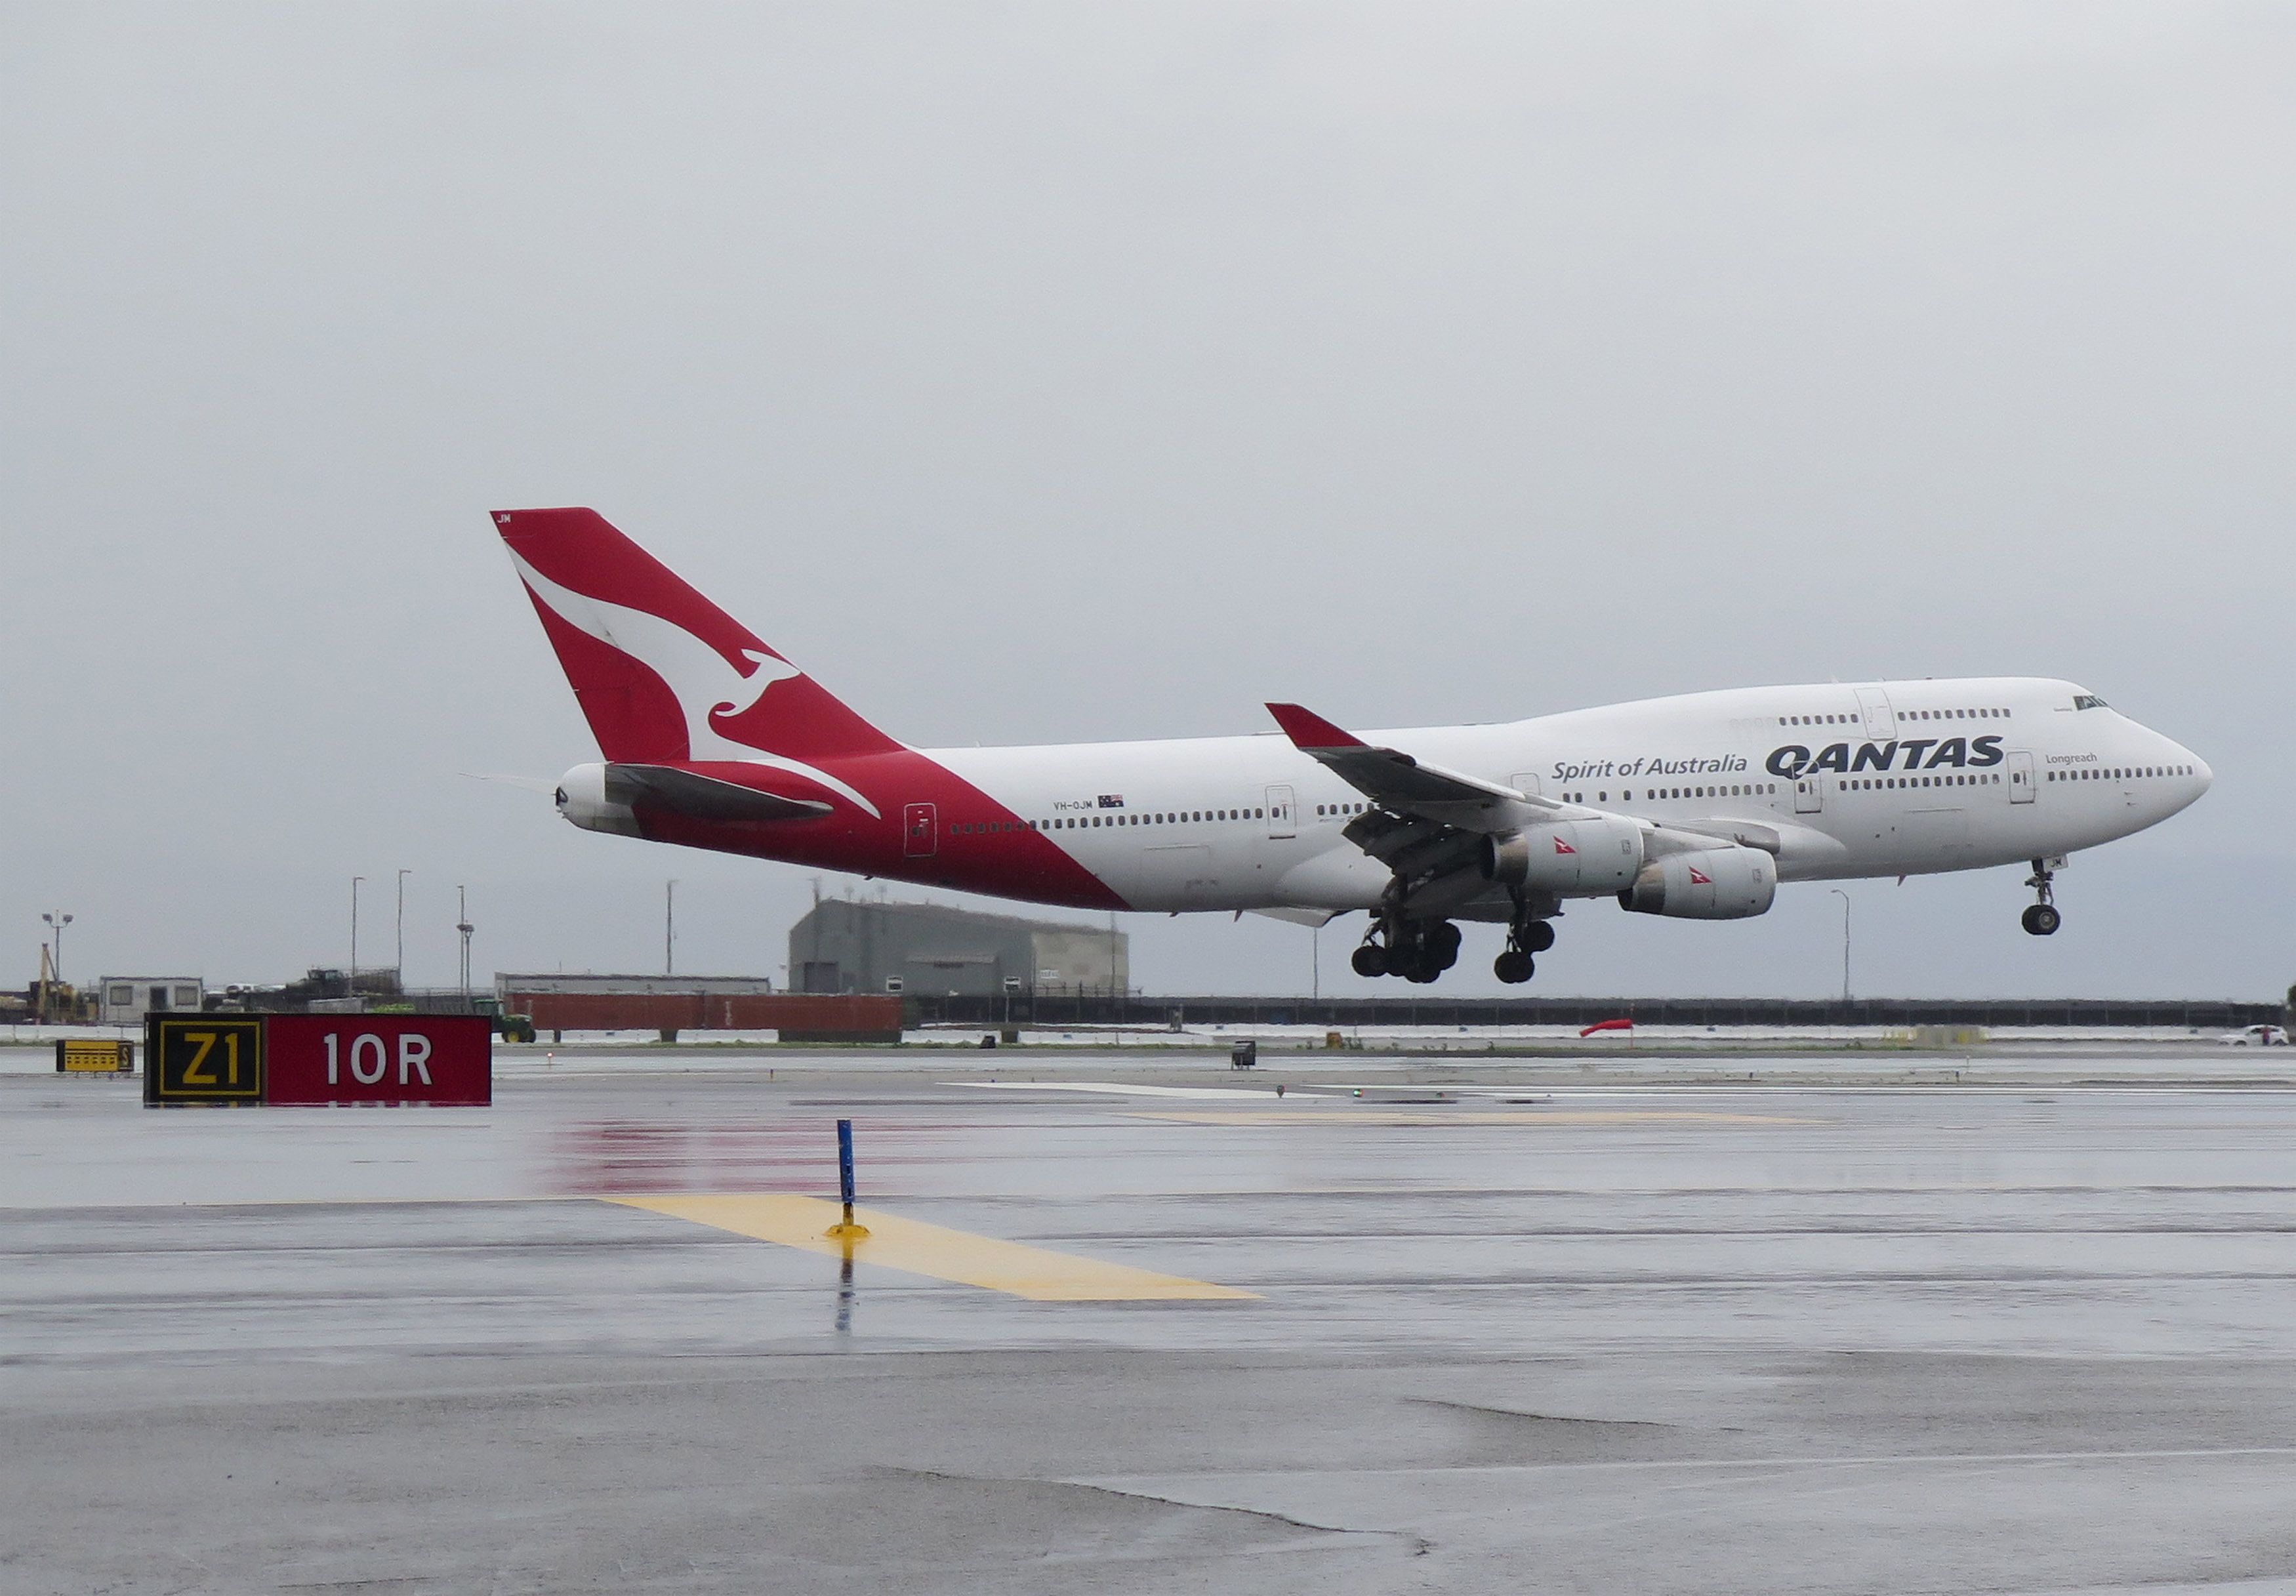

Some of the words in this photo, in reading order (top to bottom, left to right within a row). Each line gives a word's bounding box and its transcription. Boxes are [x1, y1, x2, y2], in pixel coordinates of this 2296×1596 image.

[497, 514, 511, 523] JM
[1551, 760, 1614, 783] Spirit
[1618, 757, 1645, 777] of
[1645, 754, 1748, 776] Australia
[1765, 735, 2004, 780] QANTAS
[2045, 752, 2097, 766] Longreach
[1054, 800, 1093, 810] VH-OJM
[182, 1033, 238, 1084] Z1
[323, 1033, 432, 1085] 10R
